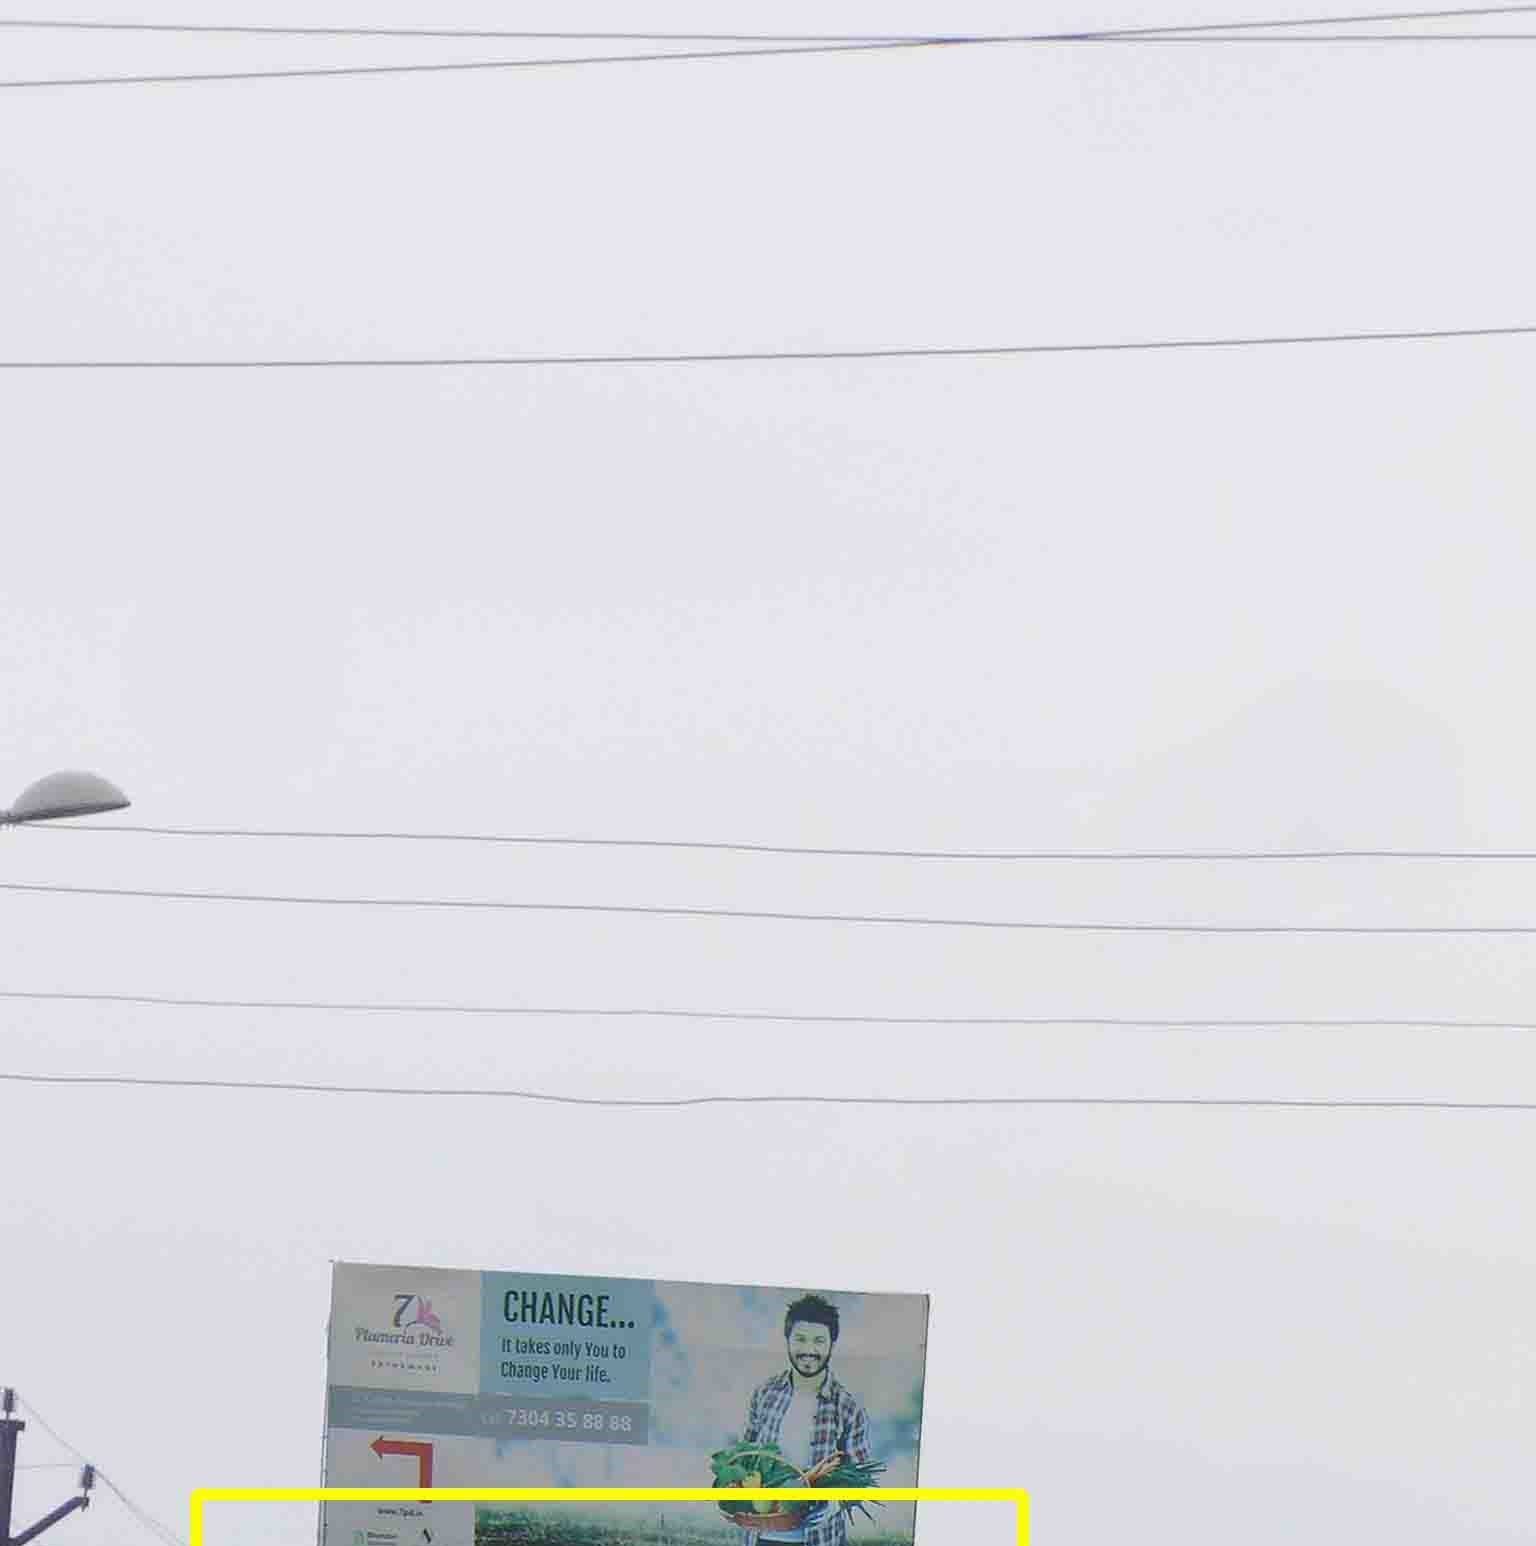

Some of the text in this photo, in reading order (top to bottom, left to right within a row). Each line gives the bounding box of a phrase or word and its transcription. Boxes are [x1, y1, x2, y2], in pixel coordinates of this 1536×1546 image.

[504, 1290, 635, 1329] CHANGE...
[501, 1338, 626, 1359] It takes only You to
[501, 1361, 612, 1384] Change Your life.
[506, 1408, 550, 1425] 7304
[553, 1410, 576, 1428] 35
[583, 1413, 605, 1430] 88
[609, 1415, 632, 1431] 88
